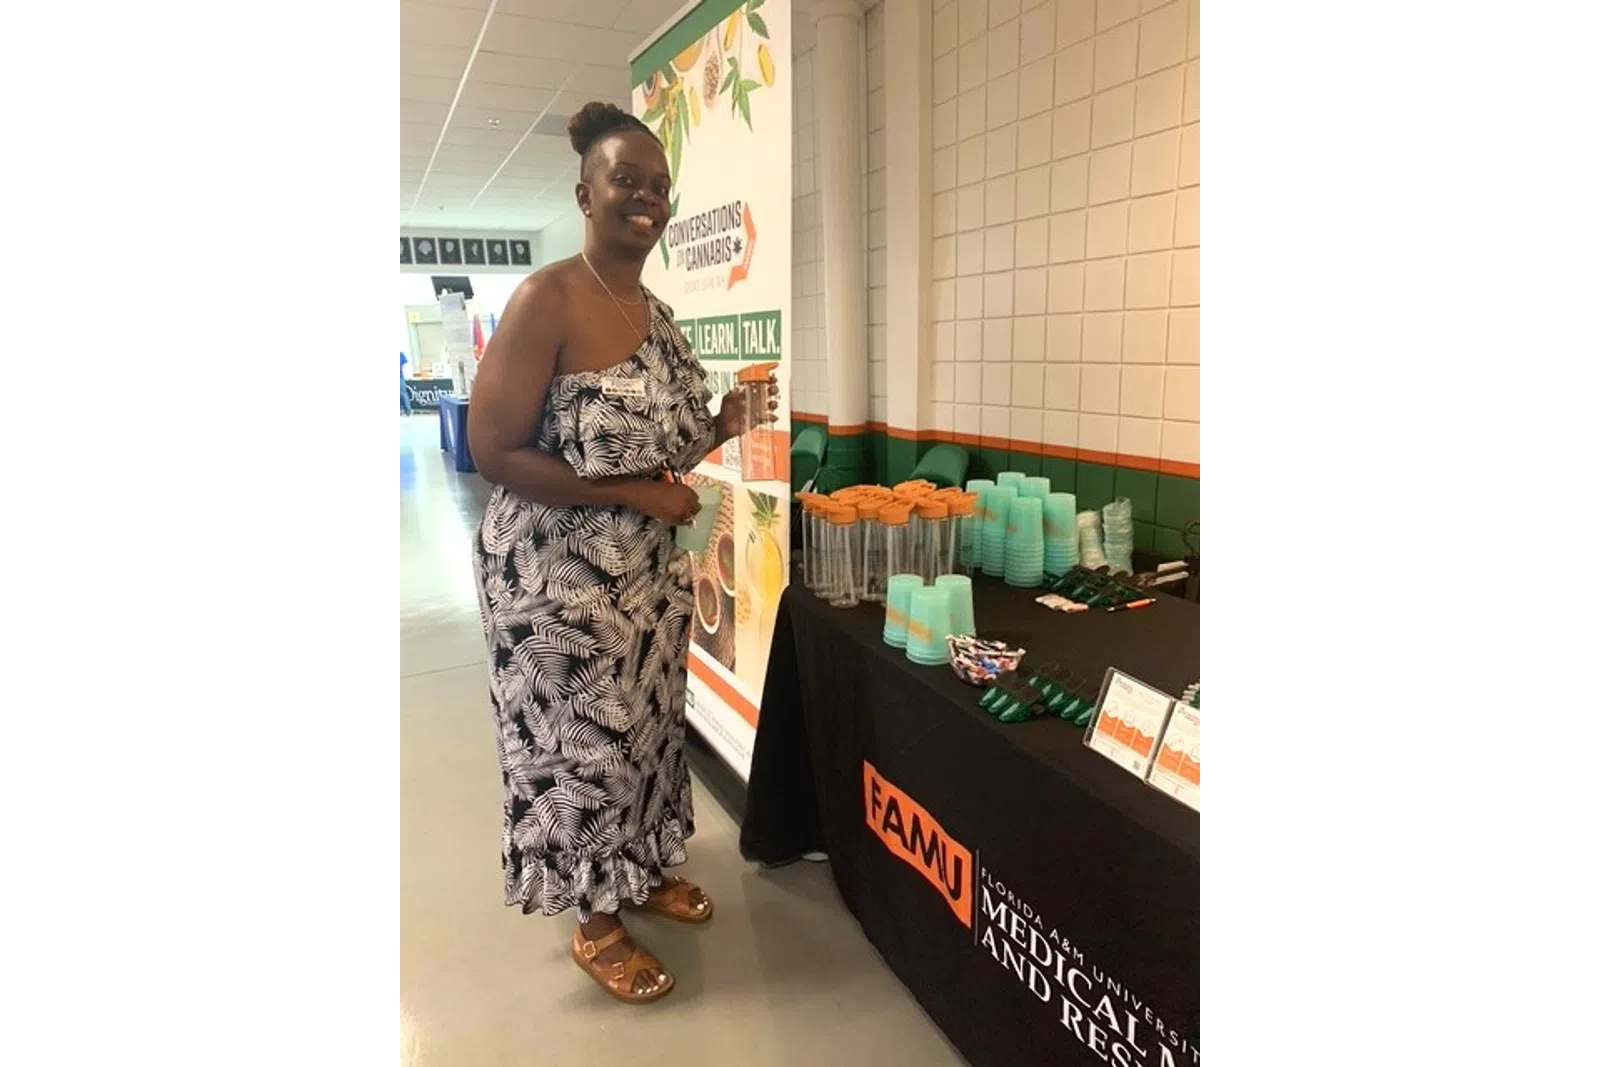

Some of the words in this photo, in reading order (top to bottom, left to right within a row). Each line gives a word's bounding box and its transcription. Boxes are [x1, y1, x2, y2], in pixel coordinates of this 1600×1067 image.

[669, 200, 741, 248] CONVERSATIONS
[685, 236, 732, 272] CANNABIS
[699, 322, 738, 355] LEARN.
[742, 319, 780, 355] TALK.
[871, 776, 963, 901] FAMU
[982, 867, 1043, 929] FLORIDA
[1049, 929, 1083, 966] A&M
[1093, 965, 1200, 1063] UNIVERSIT
[982, 885, 1147, 1058] MEDICAL
[982, 926, 1051, 1002] AND
[1060, 994, 1143, 1067] RES
